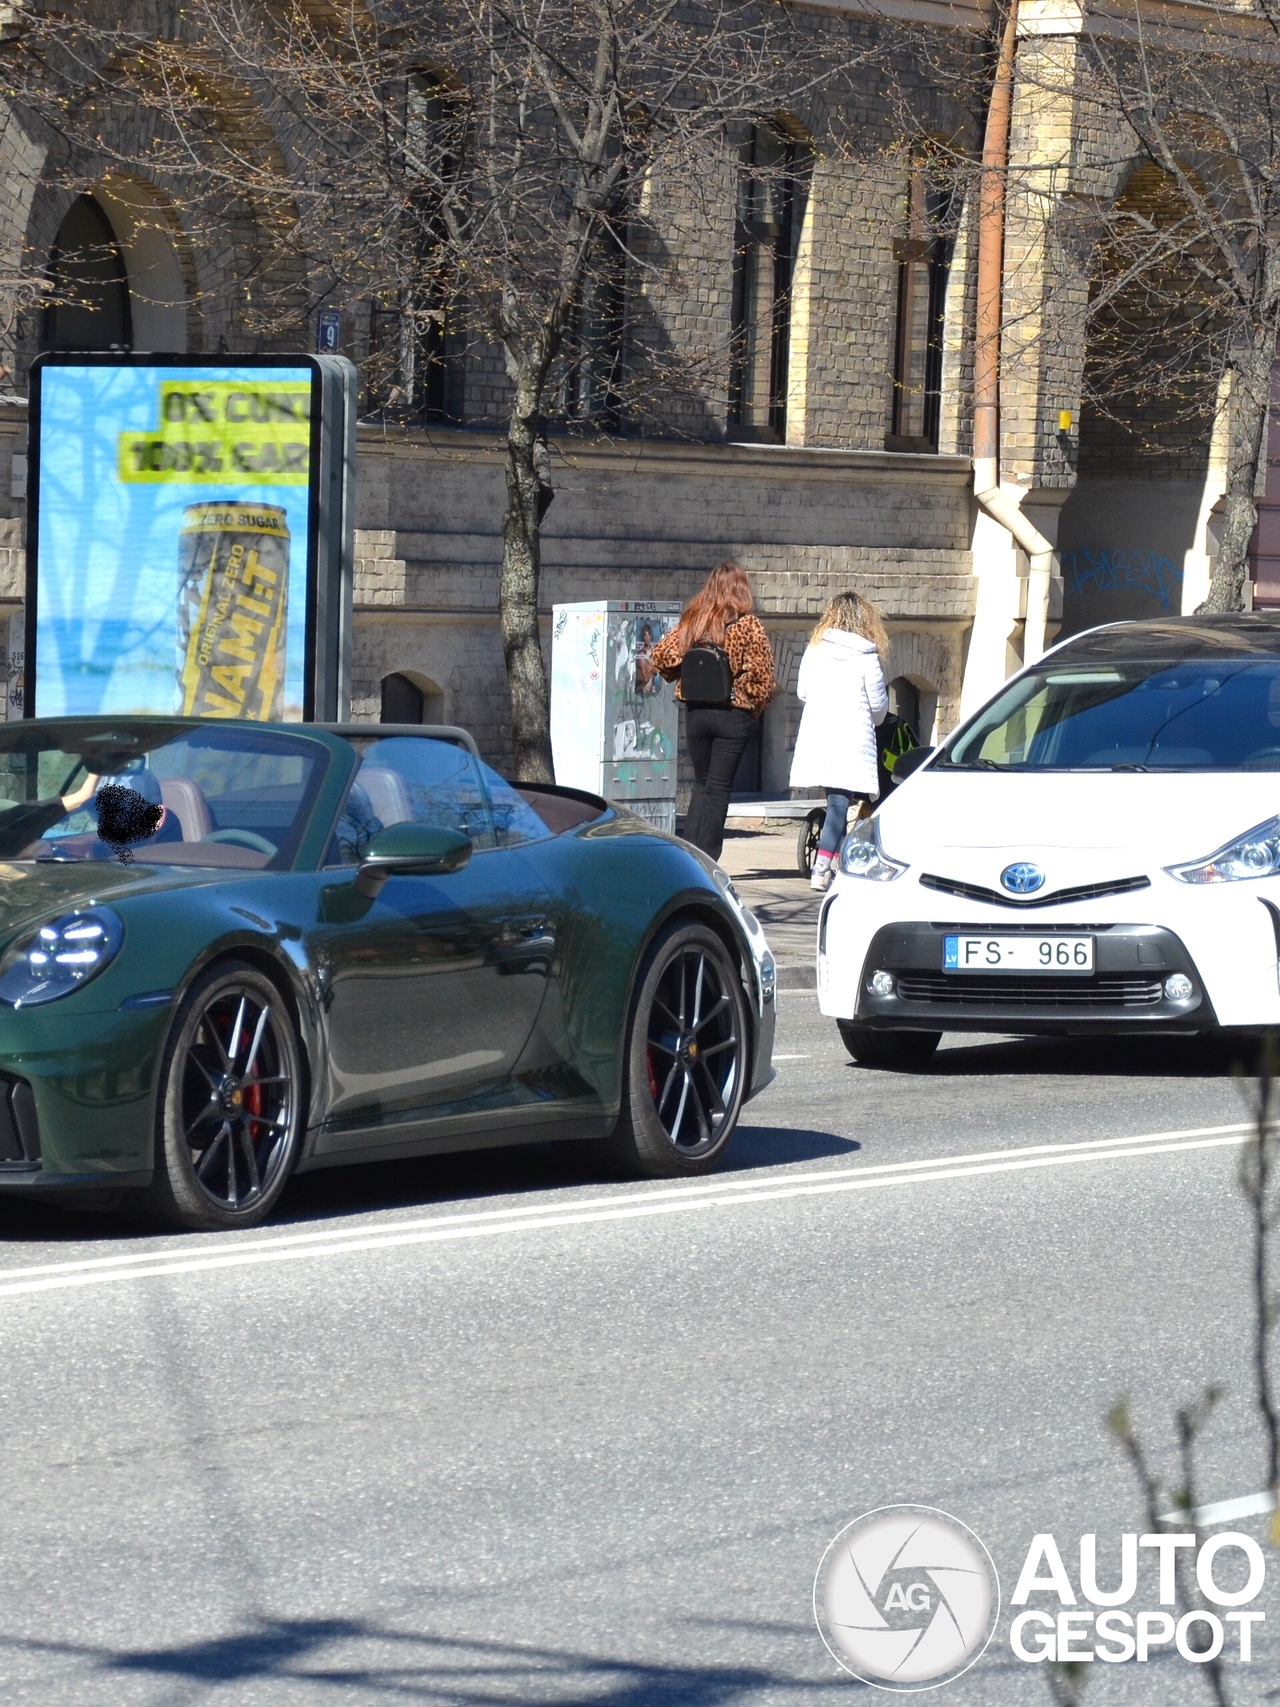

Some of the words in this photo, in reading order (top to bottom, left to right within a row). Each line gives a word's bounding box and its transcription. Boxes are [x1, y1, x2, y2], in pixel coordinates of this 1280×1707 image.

[326, 325, 335, 348] 9
[164, 391, 219, 424] 0%
[131, 441, 224, 474] 100%
[198, 513, 234, 526] ZERO
[237, 514, 280, 530] SUGAR
[198, 593, 231, 666] ORIGINAL
[222, 544, 244, 591] ZERO
[946, 955, 957, 963] LV
